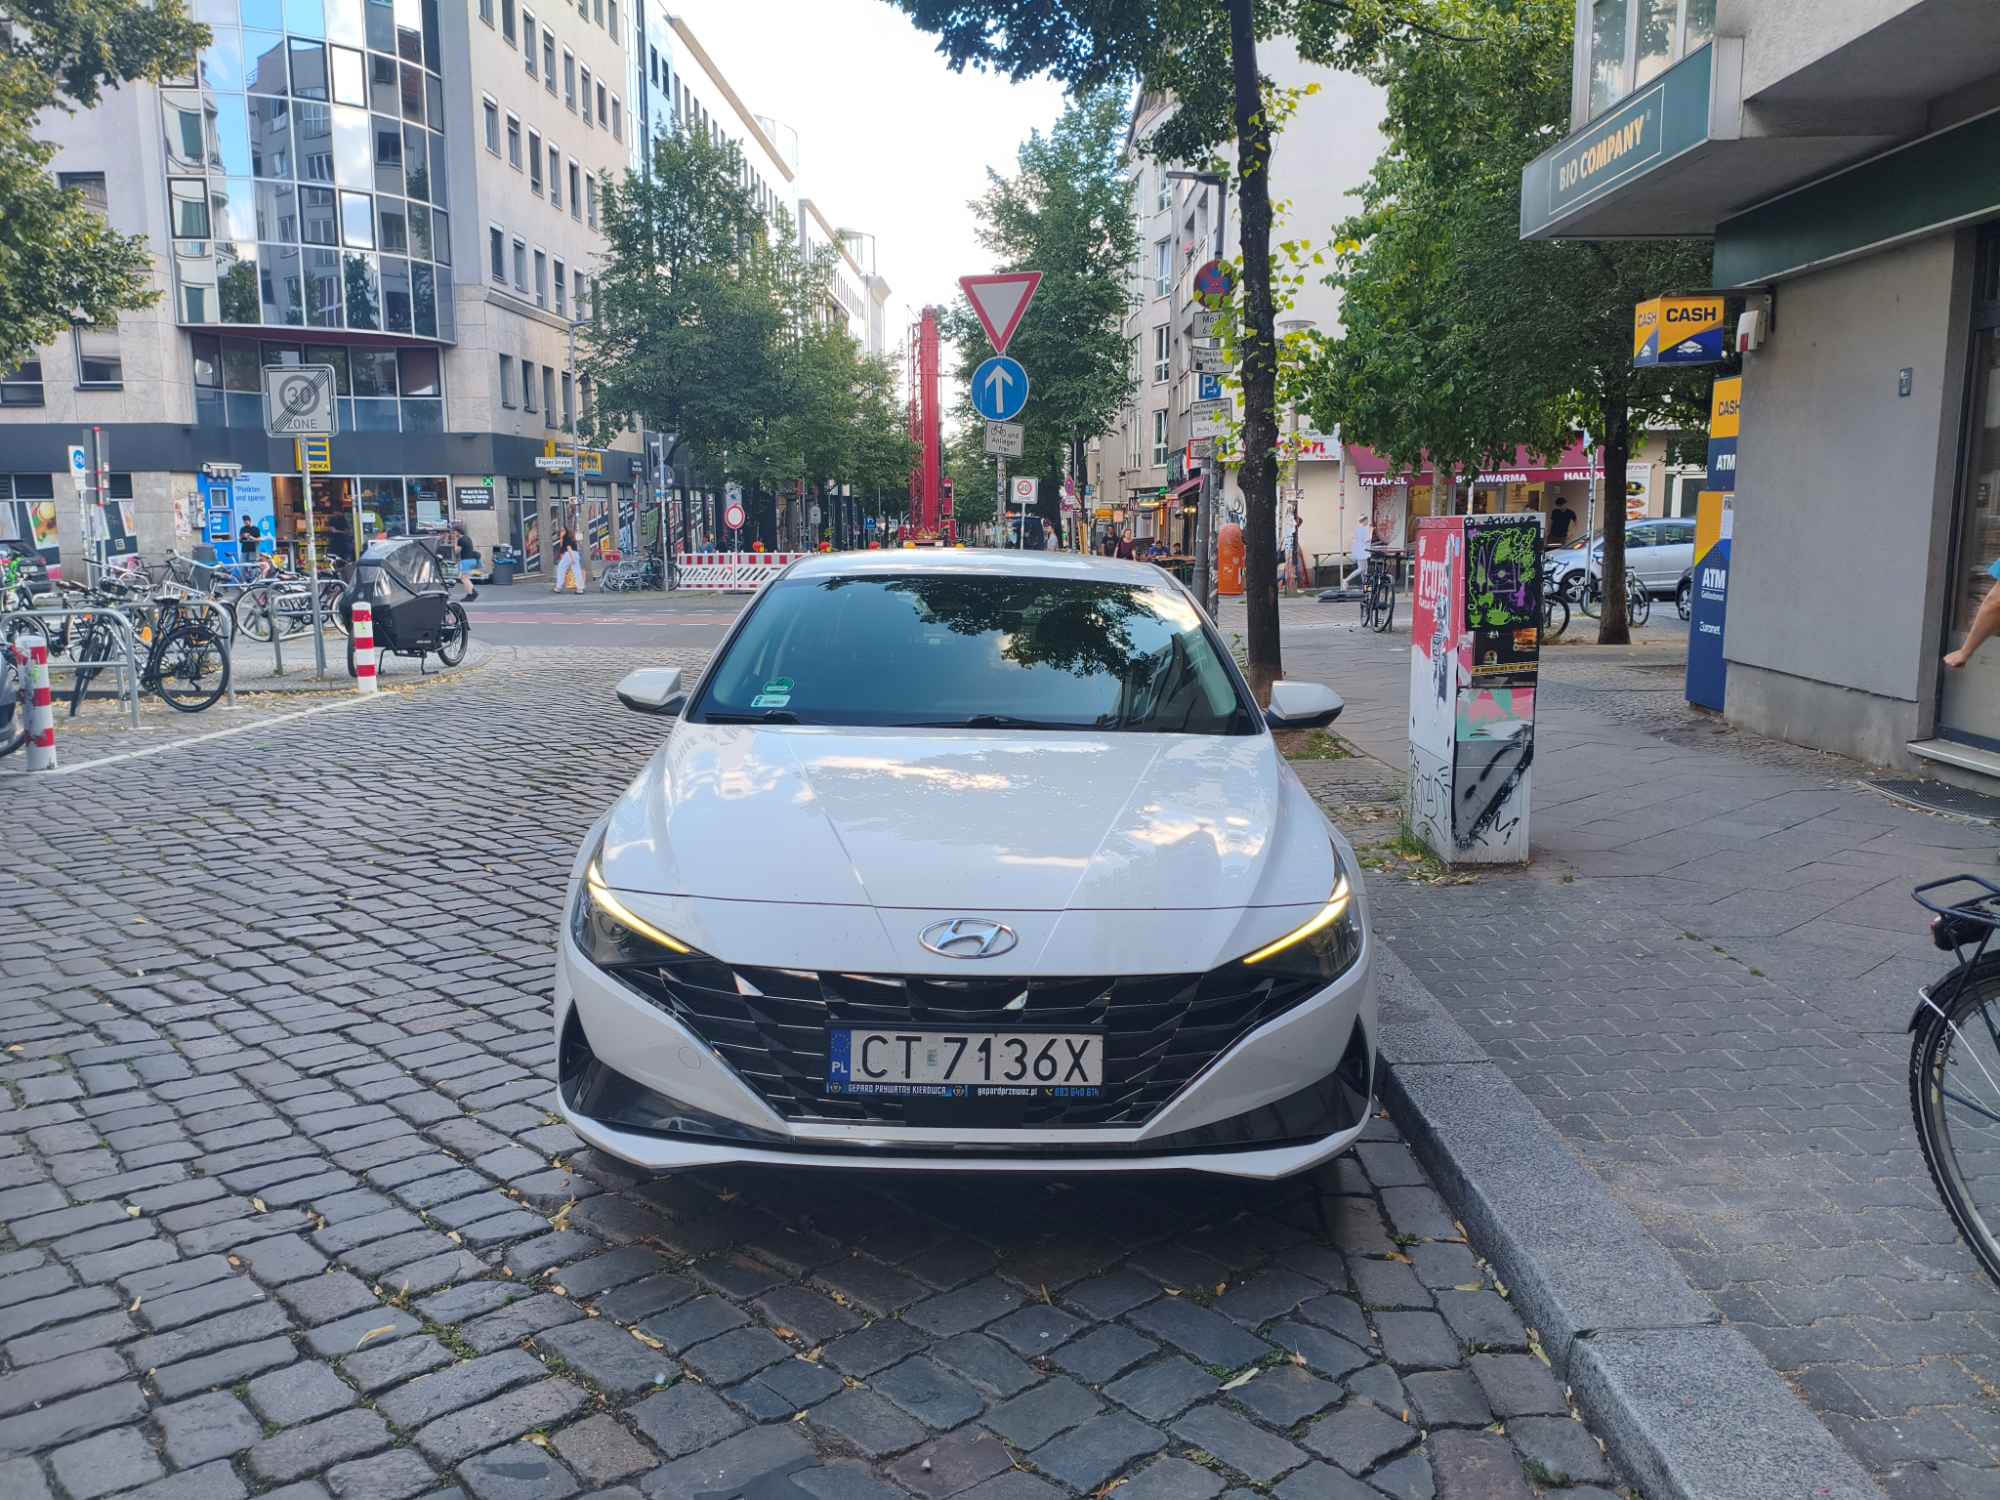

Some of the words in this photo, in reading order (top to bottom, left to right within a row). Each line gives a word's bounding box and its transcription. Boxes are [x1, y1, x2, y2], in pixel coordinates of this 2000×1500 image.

[1560, 159, 1578, 192] BIO
[1580, 114, 1645, 178] COMPANY
[1666, 307, 1717, 323] CASH
[287, 418, 318, 430] ZONE
[1715, 454, 1736, 471] ATM
[1701, 568, 1727, 590] ATM
[861, 1034, 922, 1080] CT
[943, 1037, 1091, 1083] 7136X
[831, 1061, 849, 1074] PL
